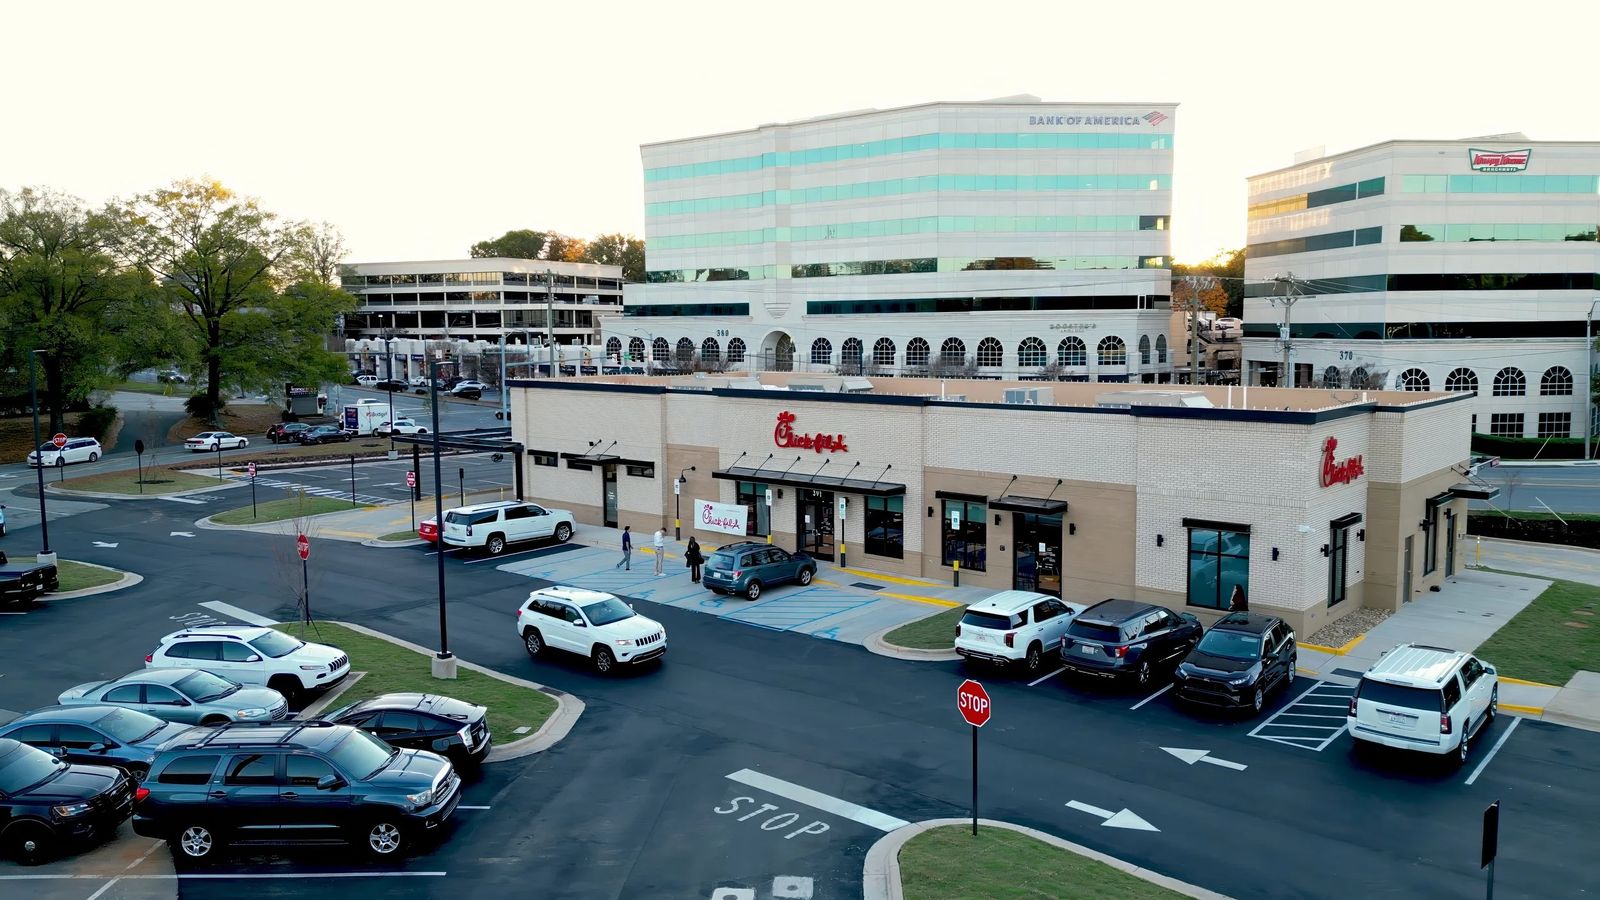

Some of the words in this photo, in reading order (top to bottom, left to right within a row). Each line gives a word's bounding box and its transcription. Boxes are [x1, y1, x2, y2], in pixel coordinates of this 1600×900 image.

[1029, 116, 1063, 126] BANK
[1066, 116, 1082, 126] OF
[1084, 116, 1141, 126] AMERICA
[1340, 351, 1352, 360] 370
[960, 691, 988, 714] STOP
[713, 797, 830, 839] STOP
